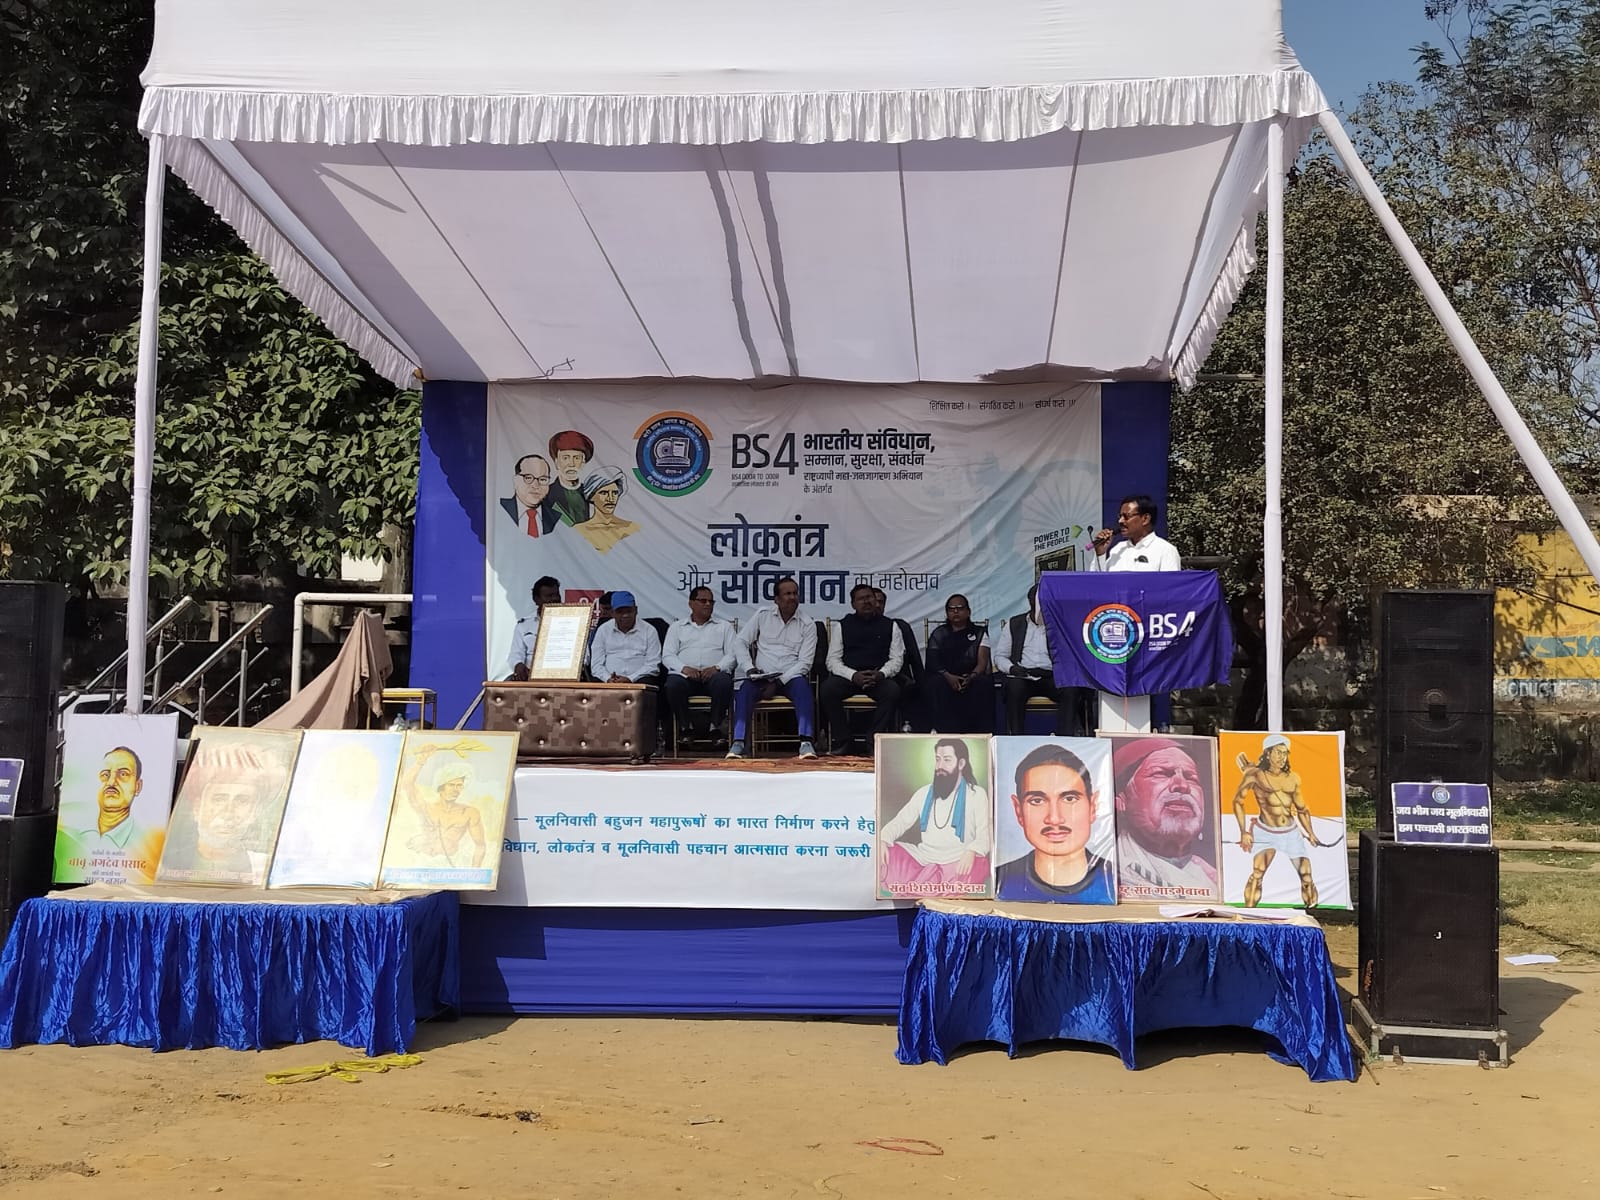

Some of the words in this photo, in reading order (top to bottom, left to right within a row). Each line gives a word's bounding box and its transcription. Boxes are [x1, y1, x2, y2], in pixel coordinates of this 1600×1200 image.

[804, 429, 864, 450] भारतीय
[867, 428, 935, 453] संविधान,
[731, 432, 799, 475] BS4
[804, 454, 848, 467] सम्मान,
[850, 454, 886, 469] सुरक्षा,
[888, 451, 925, 466] संवर्धन
[804, 471, 833, 482] राष्ट्रव्यापी
[892, 471, 923, 480] अभियान
[804, 484, 810, 493] के
[811, 484, 832, 494] अंतर्गत
[707, 512, 829, 557] लोकतंत्र
[1034, 530, 1059, 544] POWER
[1060, 527, 1070, 537] TO
[1034, 542, 1046, 551] THE
[1047, 536, 1070, 548] PEOPLE
[677, 565, 714, 592] और
[878, 567, 941, 591] महोत्सव
[1149, 611, 1196, 638] BS4
[1396, 806, 1411, 816] जय
[1412, 805, 1429, 816] भीम
[1430, 807, 1445, 816] जय
[1446, 805, 1489, 820] मूलनिवासी
[535, 812, 597, 830] मूलनिवासी
[604, 816, 643, 831] बहुजन
[713, 817, 731, 829] का
[737, 817, 768, 829] भारत
[775, 814, 815, 830] निर्माण
[821, 816, 850, 830] करने
[857, 816, 875, 835] हेतु
[503, 839, 539, 854] विधान,
[547, 838, 595, 854] लोकतंत्र
[601, 843, 611, 853] व
[617, 840, 680, 857] मूलनिवासी
[687, 843, 728, 855] पहचान
[734, 844, 789, 856] आत्मसात
[795, 845, 829, 857] करना
[835, 843, 872, 858] जरूरी
[889, 882, 906, 892] संत
[909, 881, 955, 892] शिरोमणि
[1135, 884, 1151, 894] संत
